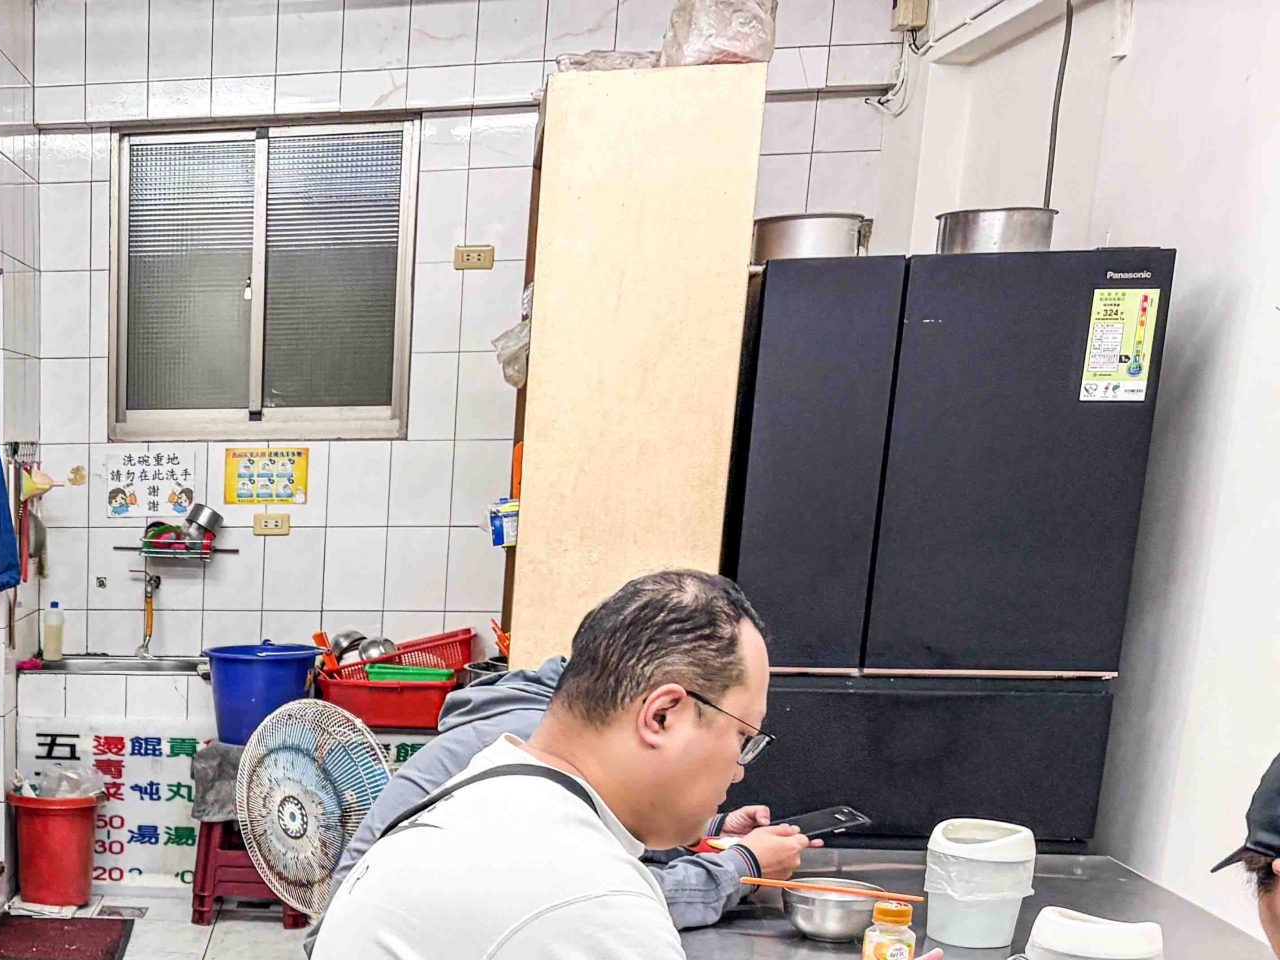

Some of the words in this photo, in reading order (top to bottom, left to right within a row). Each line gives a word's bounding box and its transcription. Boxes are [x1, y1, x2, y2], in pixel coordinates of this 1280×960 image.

[1106, 270, 1152, 280] Panasonic
[1102, 309, 1119, 317] 324
[122, 452, 180, 467] 洗碗重地
[109, 467, 192, 482] 請勿在此洗手
[147, 484, 160, 512] 謝謝
[163, 737, 200, 847] 貢丸湯
[94, 840, 125, 855] 30
[92, 866, 124, 881] 20
